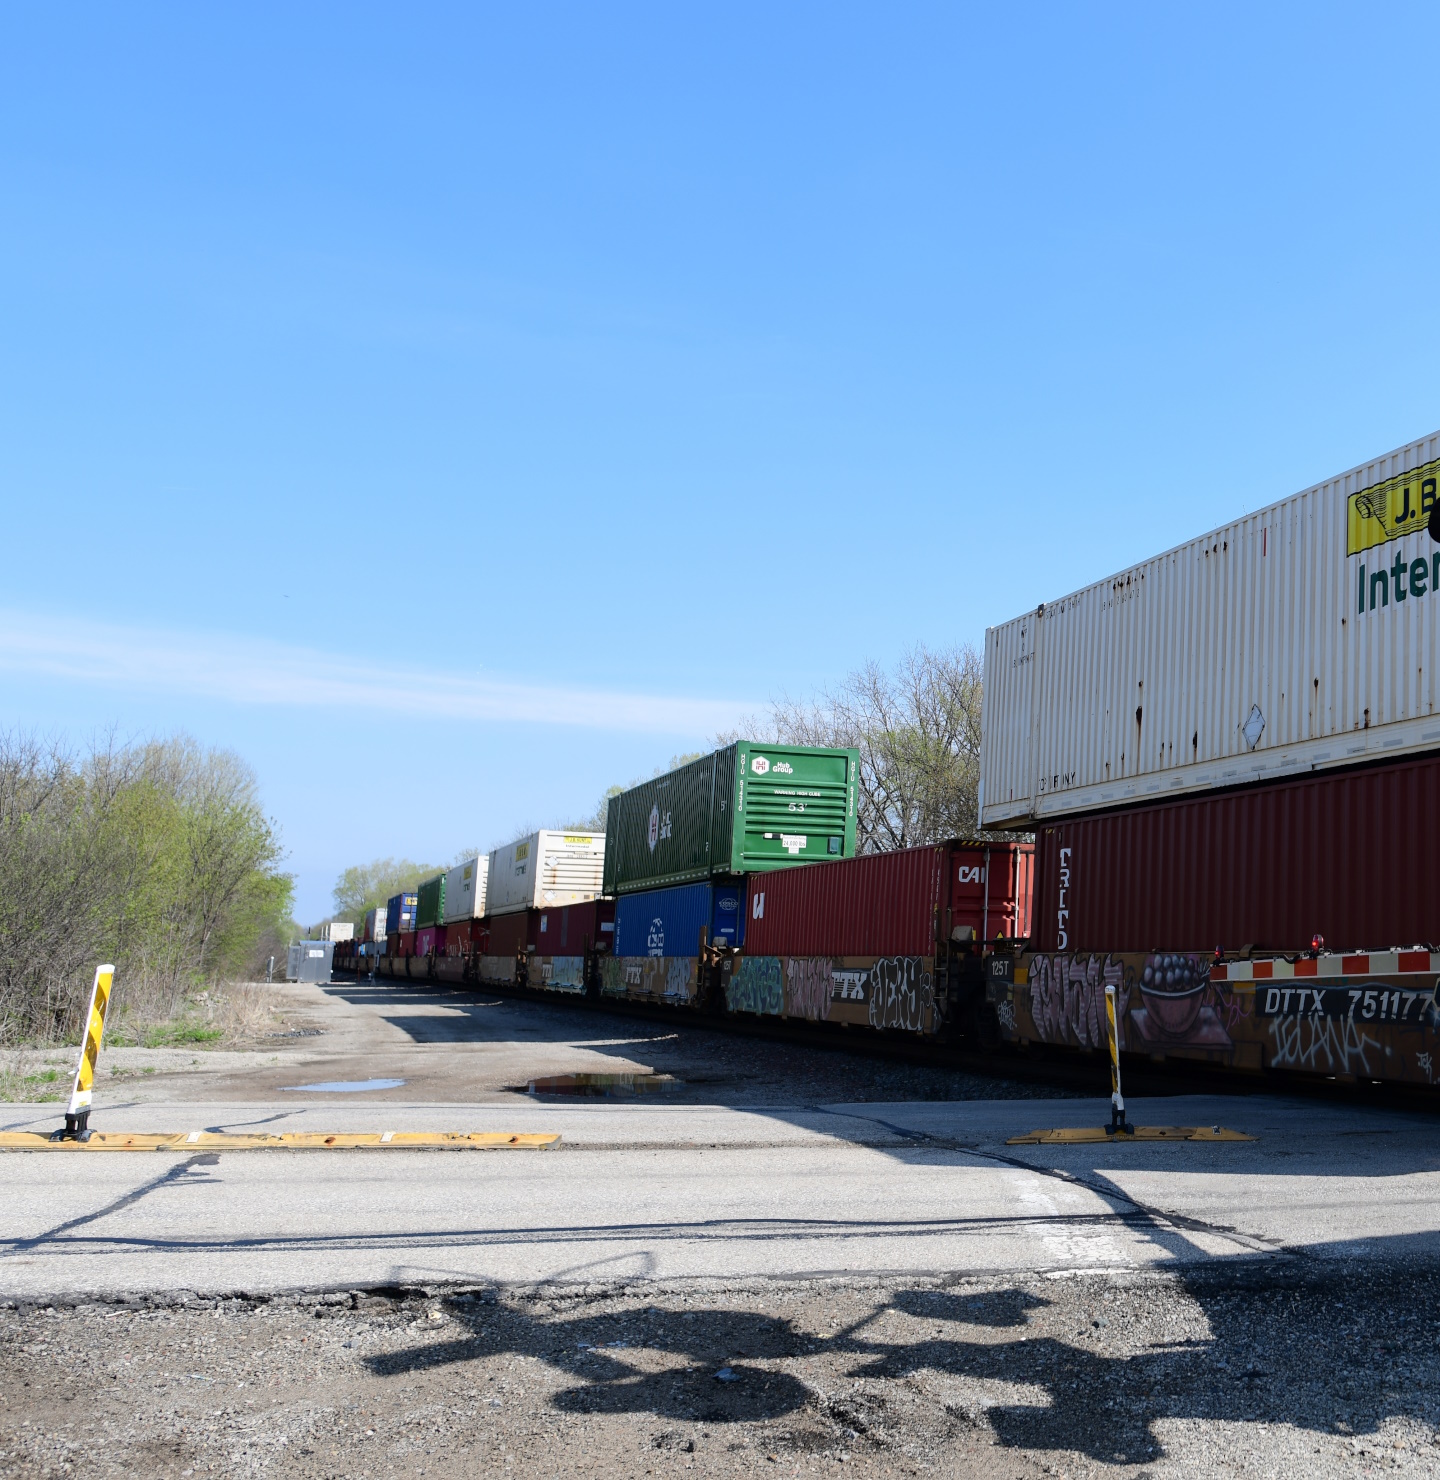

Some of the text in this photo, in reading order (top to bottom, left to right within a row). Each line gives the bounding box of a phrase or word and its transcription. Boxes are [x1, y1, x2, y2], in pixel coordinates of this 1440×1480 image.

[772, 765, 793, 774] Group
[777, 761, 790, 769] Hub
[788, 802, 807, 812] 53'
[958, 866, 986, 884] CAI
[1057, 848, 1072, 951] TRITO
[991, 960, 1009, 976] 125T
[830, 971, 868, 1000] TTX
[1264, 988, 1435, 1022] DTTX 751177
